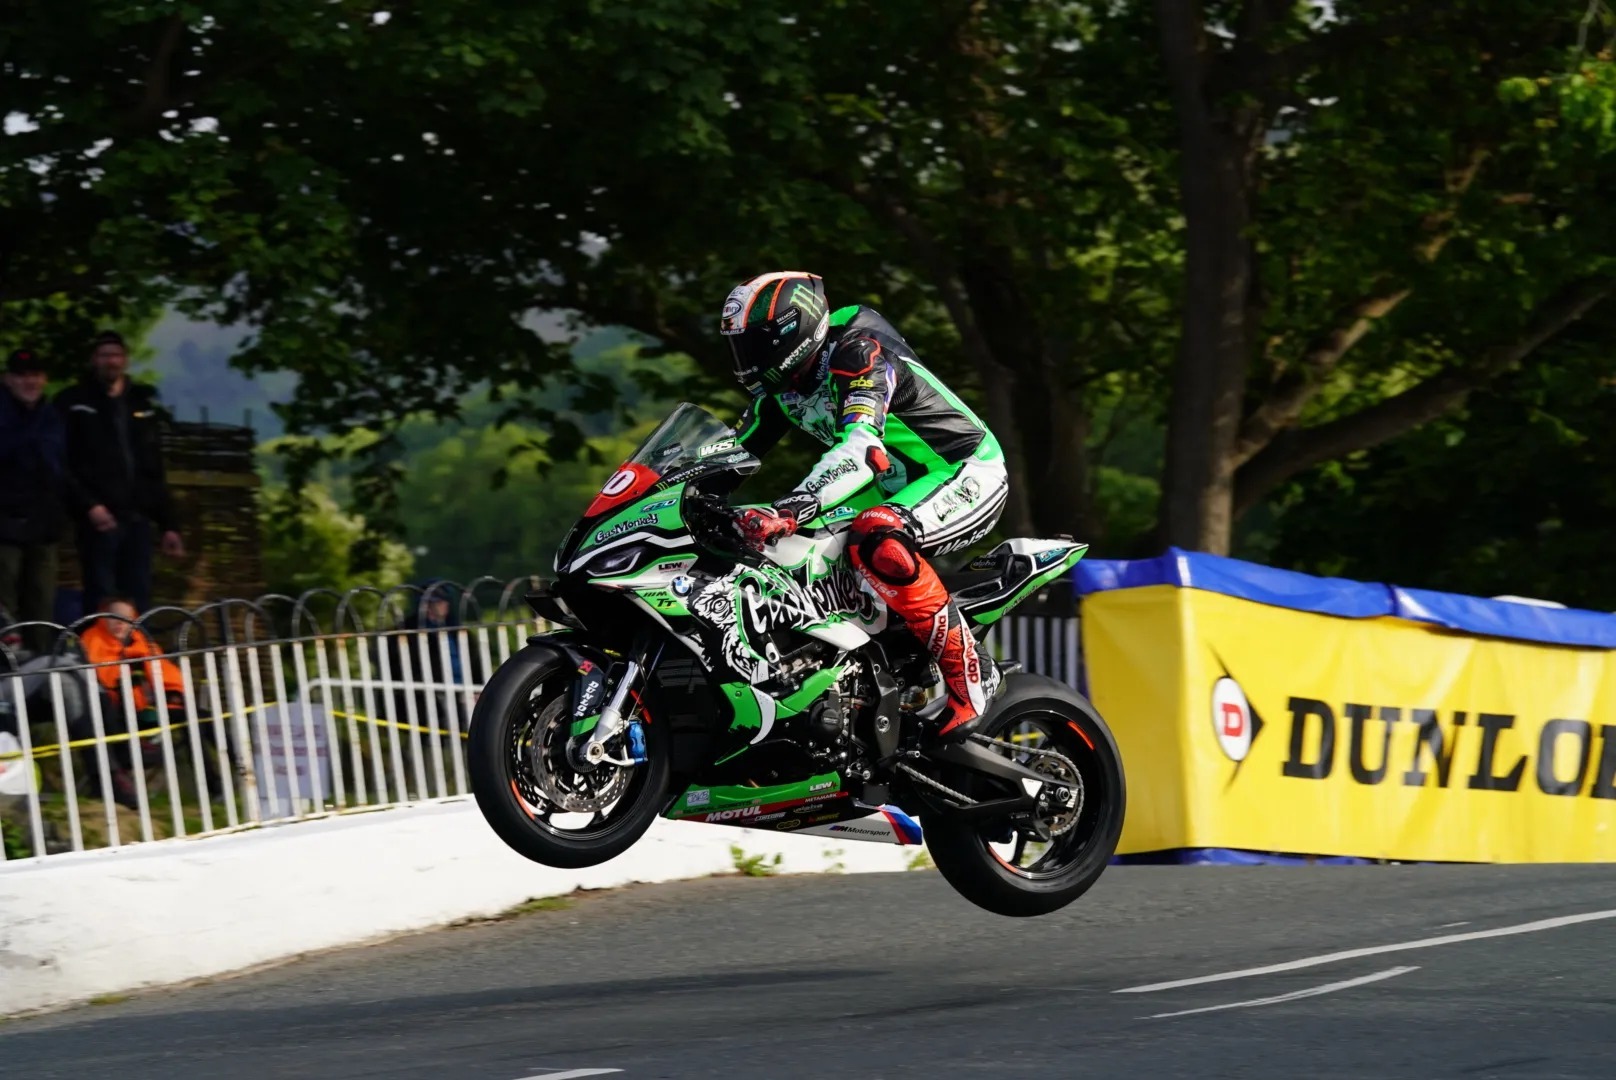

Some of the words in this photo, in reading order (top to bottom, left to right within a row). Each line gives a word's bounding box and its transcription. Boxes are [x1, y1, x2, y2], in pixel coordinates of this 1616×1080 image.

[861, 510, 895, 523] Weise
[933, 519, 997, 557] Weise
[858, 563, 898, 598] Weise
[573, 680, 600, 717] DUNLOP
[1221, 703, 1243, 737] D
[705, 805, 762, 822] MOTUL
[847, 827, 891, 837] Motorsport
